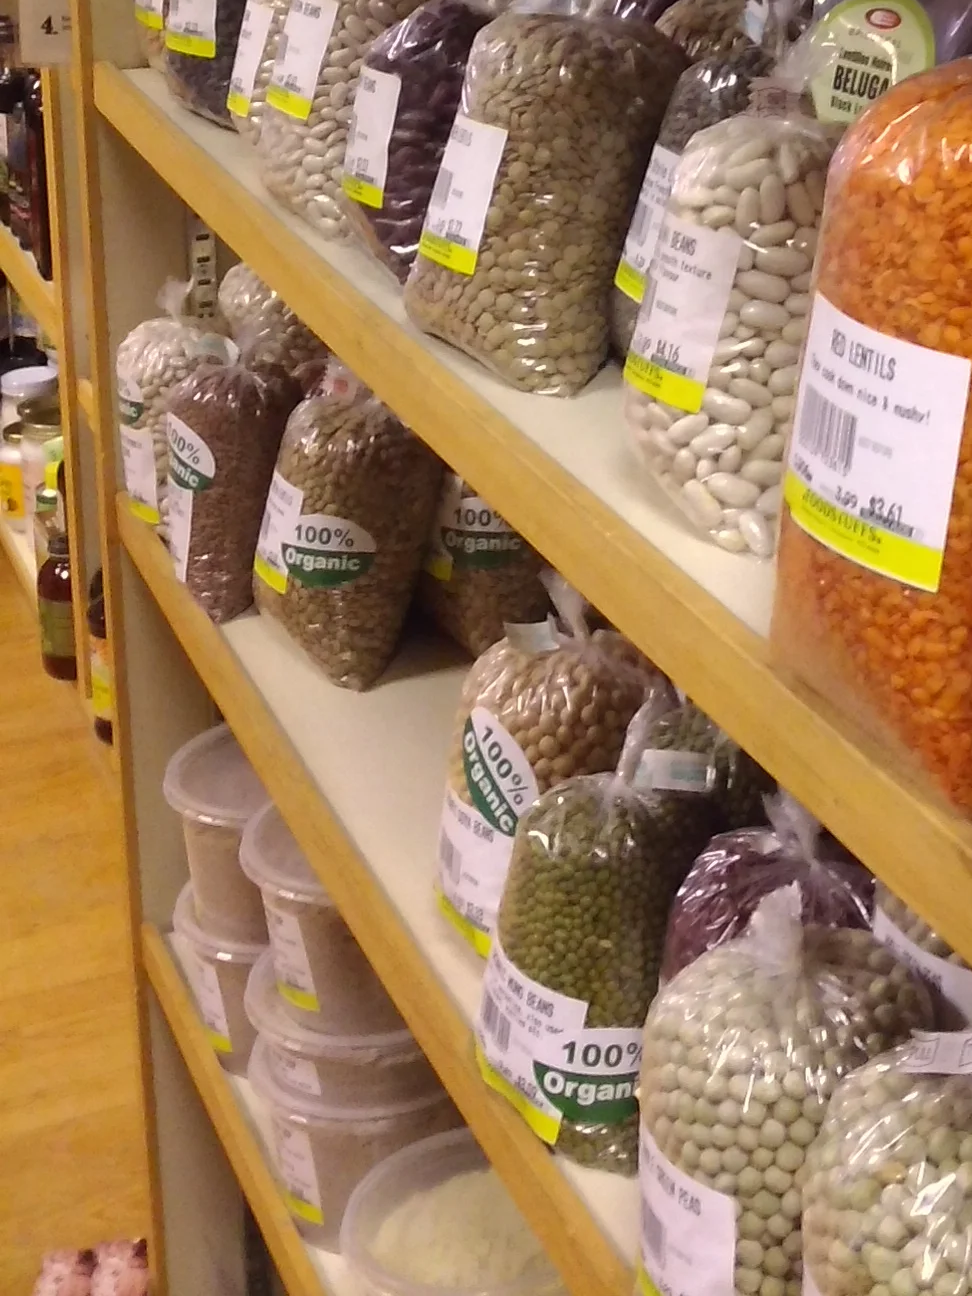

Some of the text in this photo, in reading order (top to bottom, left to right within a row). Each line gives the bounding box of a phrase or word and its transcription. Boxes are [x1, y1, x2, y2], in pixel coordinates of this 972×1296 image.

[848, 333, 898, 382] LENTILS
[294, 524, 355, 548] 100%
[445, 530, 522, 554] Organic
[285, 547, 361, 572] Organic
[463, 730, 515, 833] Organic
[481, 724, 530, 807] 100%
[542, 1071, 638, 1106] Organ
